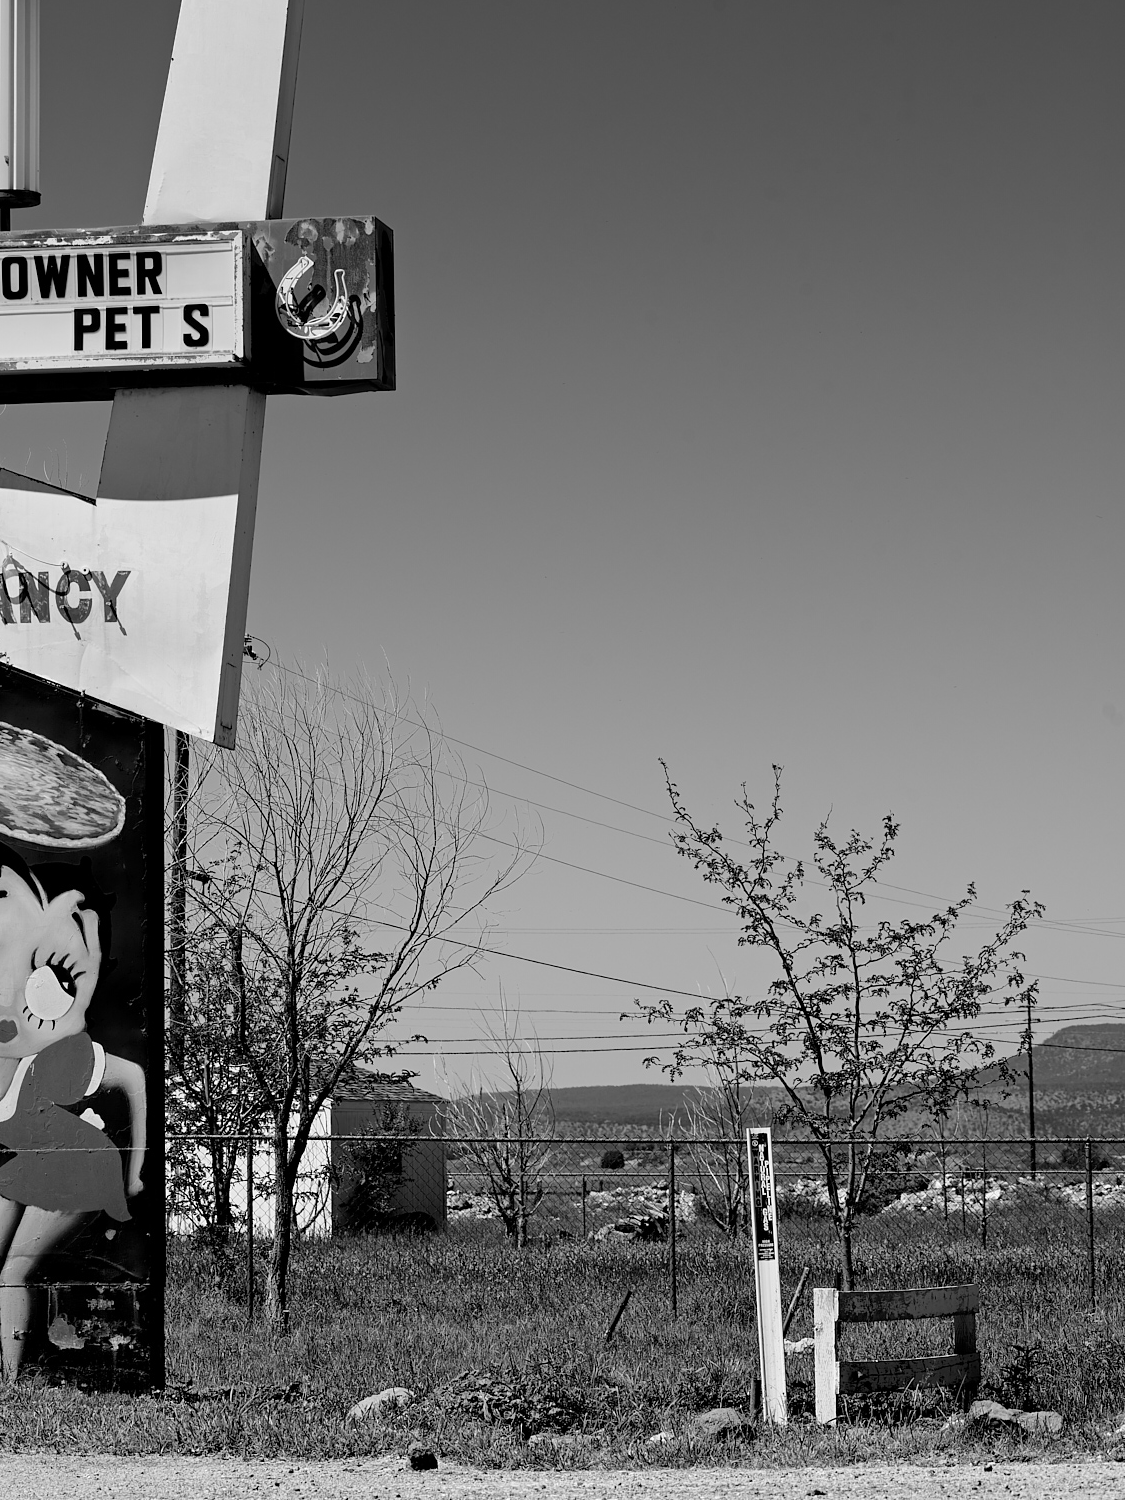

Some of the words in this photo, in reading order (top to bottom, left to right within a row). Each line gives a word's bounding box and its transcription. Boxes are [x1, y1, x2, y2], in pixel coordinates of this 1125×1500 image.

[1, 251, 163, 300] OWNER
[758, 1143, 767, 1196] NATURAL
[764, 1160, 773, 1221] PIPELINE
[762, 1207, 770, 1231] GAS
